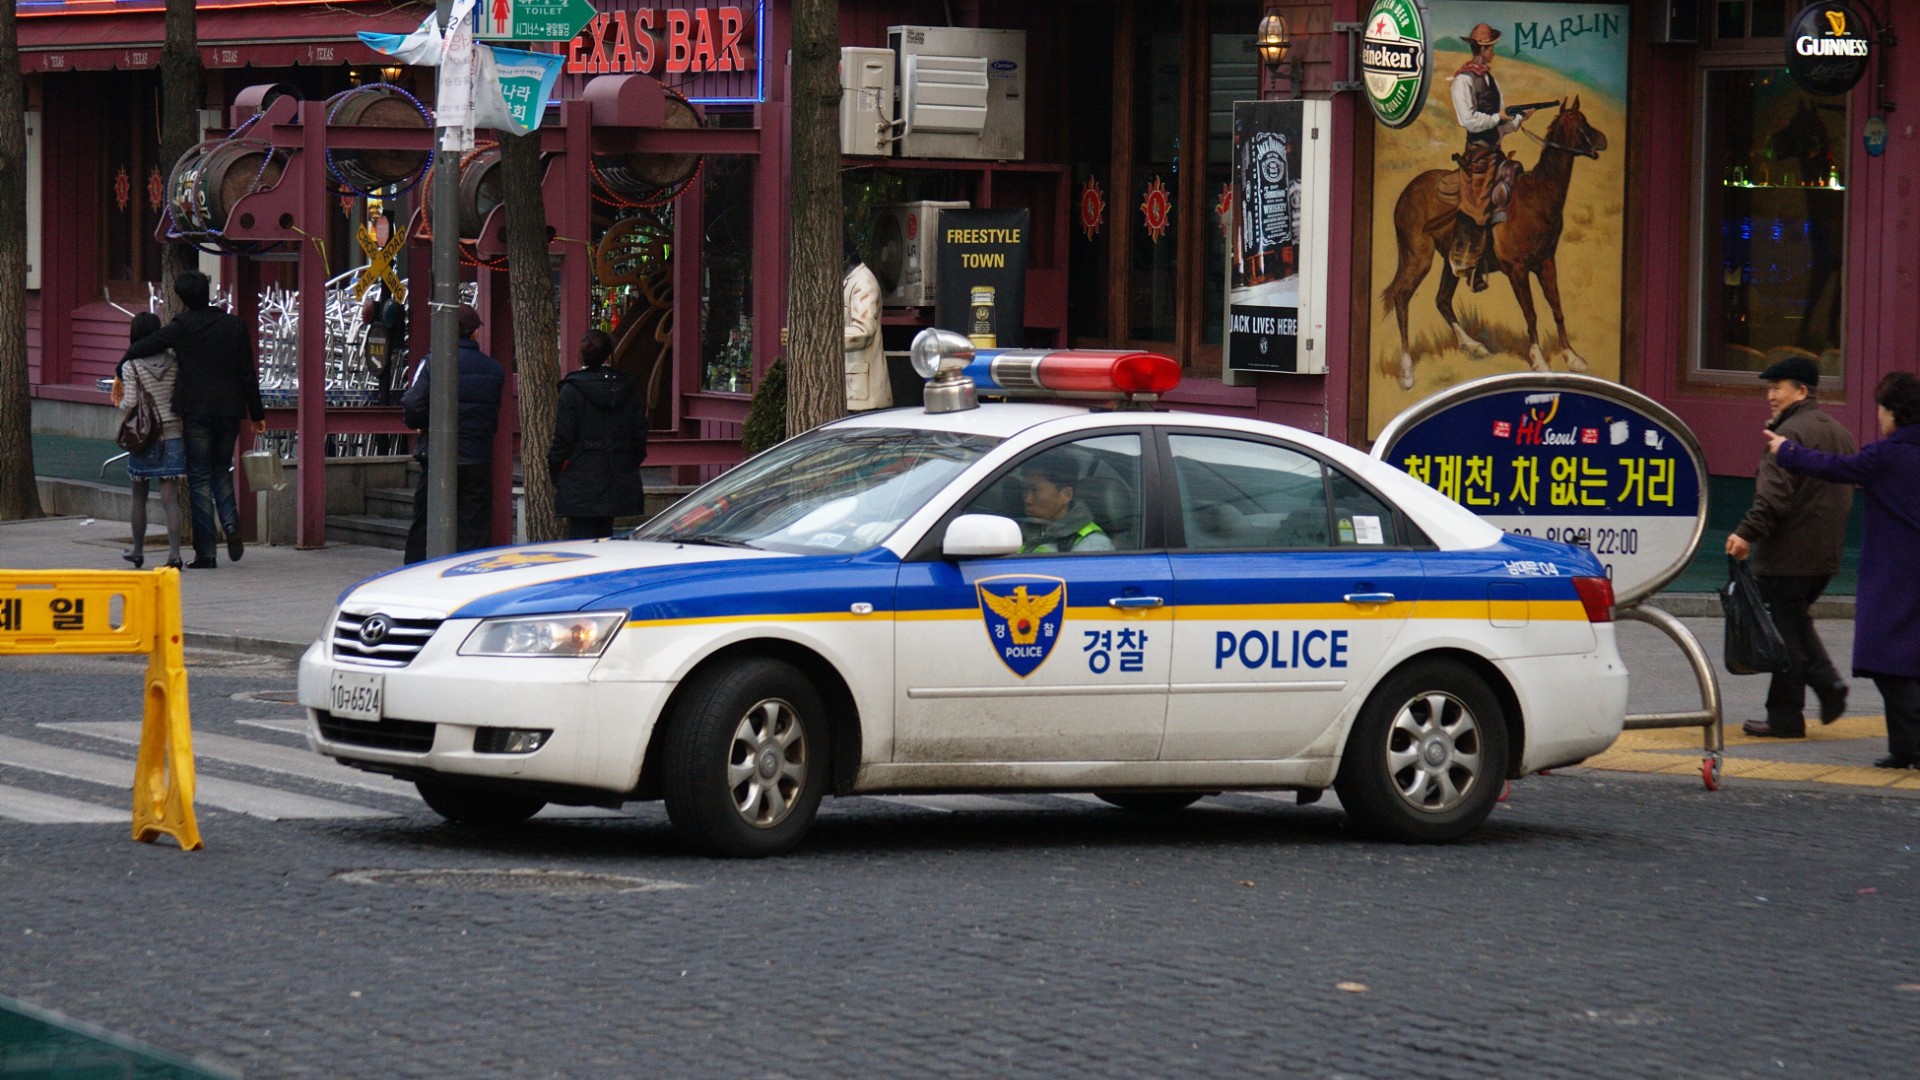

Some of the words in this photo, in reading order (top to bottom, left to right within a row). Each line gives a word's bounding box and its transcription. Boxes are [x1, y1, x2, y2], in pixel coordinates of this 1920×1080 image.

[525, 7, 563, 15] TOILET
[1394, 4, 1410, 28] BEER
[553, 8, 655, 73] EXAS
[666, 7, 745, 73] BAR
[1513, 12, 1620, 57] MARLIN
[222, 50, 238, 62] TEXAS
[316, 48, 334, 60] TEXAS
[1796, 35, 1869, 56] GUINNESS
[1363, 44, 1413, 69] eineken
[500, 83, 531, 102] 나라
[1386, 84, 1408, 113] QUALITY
[382, 230, 406, 263] ROAD
[946, 229, 1021, 244] FREESTYLE
[907, 244, 916, 257] LG
[961, 253, 1005, 268] TOWN
[1229, 314, 1250, 334] JACK
[1252, 316, 1275, 335] LIVES
[1277, 318, 1298, 336] HERE
[1542, 426, 1577, 446] Seoul
[1509, 456, 1540, 506] 차
[1551, 456, 1608, 507] 없는
[1617, 457, 1675, 507] 거리
[1597, 528, 1638, 555] 22:00
[995, 624, 1006, 639] 경
[1043, 622, 1055, 637] 찰
[1006, 646, 1042, 659] POLICE
[1083, 628, 1148, 675] 경찰
[1215, 629, 1349, 669] POLICE
